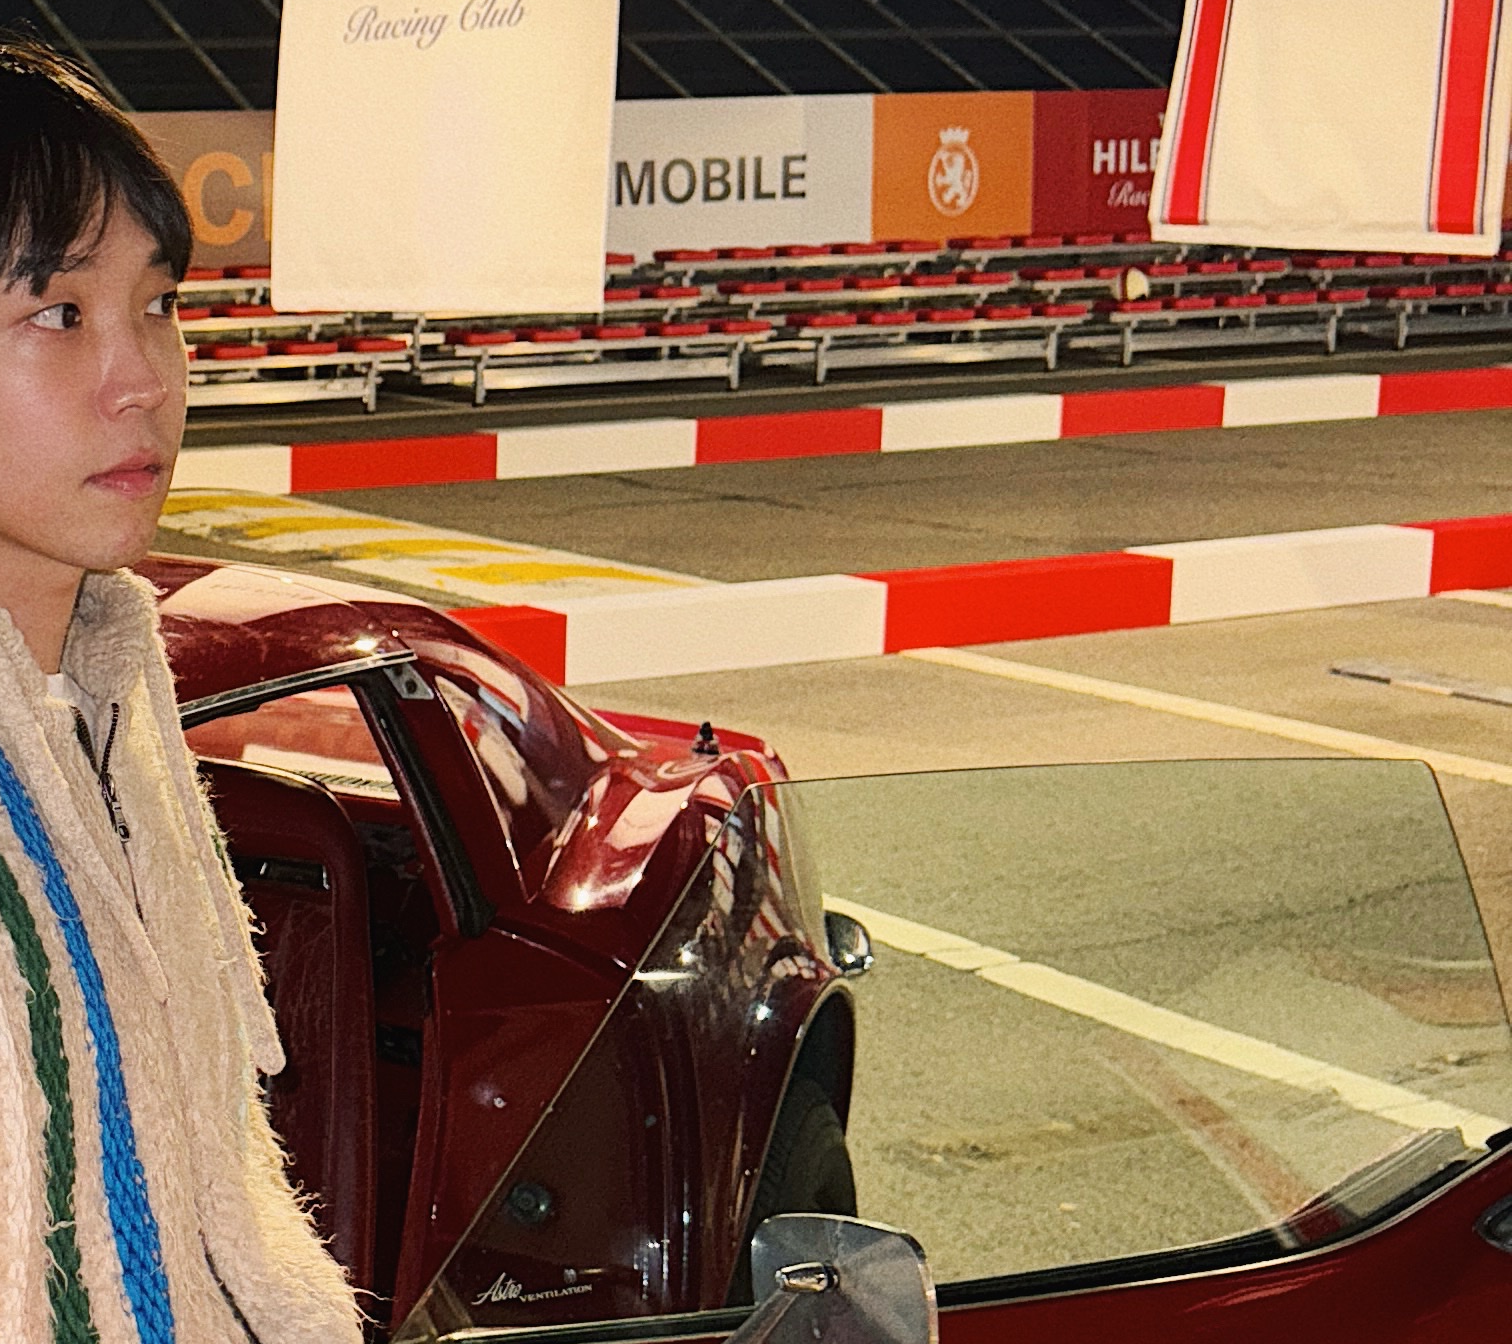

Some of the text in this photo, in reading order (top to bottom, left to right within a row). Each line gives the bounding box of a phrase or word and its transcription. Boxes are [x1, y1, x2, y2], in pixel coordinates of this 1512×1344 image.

[343, 6, 447, 50] Racing
[615, 154, 807, 206] MOBILE
[471, 1272, 592, 1305] Astro VENTILATION
